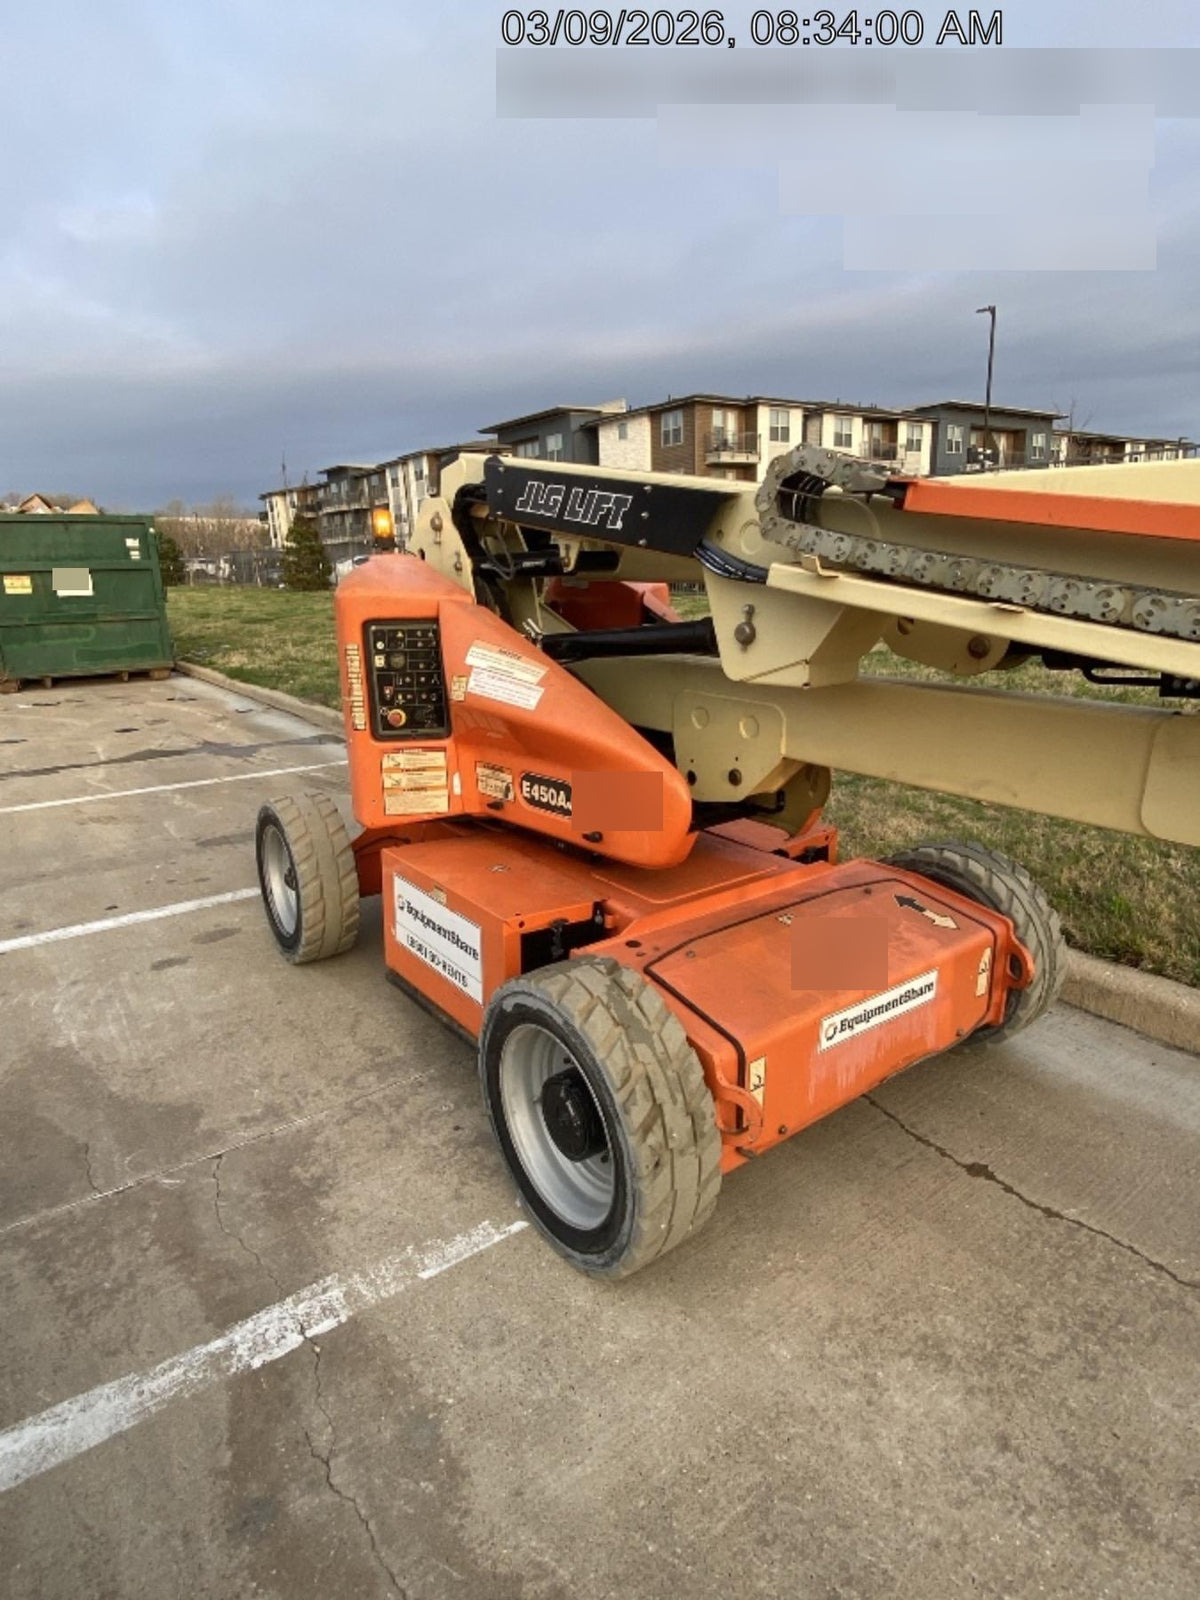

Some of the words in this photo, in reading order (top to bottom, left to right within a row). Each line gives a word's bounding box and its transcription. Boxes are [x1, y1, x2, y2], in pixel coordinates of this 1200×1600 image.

[515, 480, 566, 517] JLG
[563, 486, 633, 530] LIFT
[837, 980, 935, 1034] EquipmentShare
